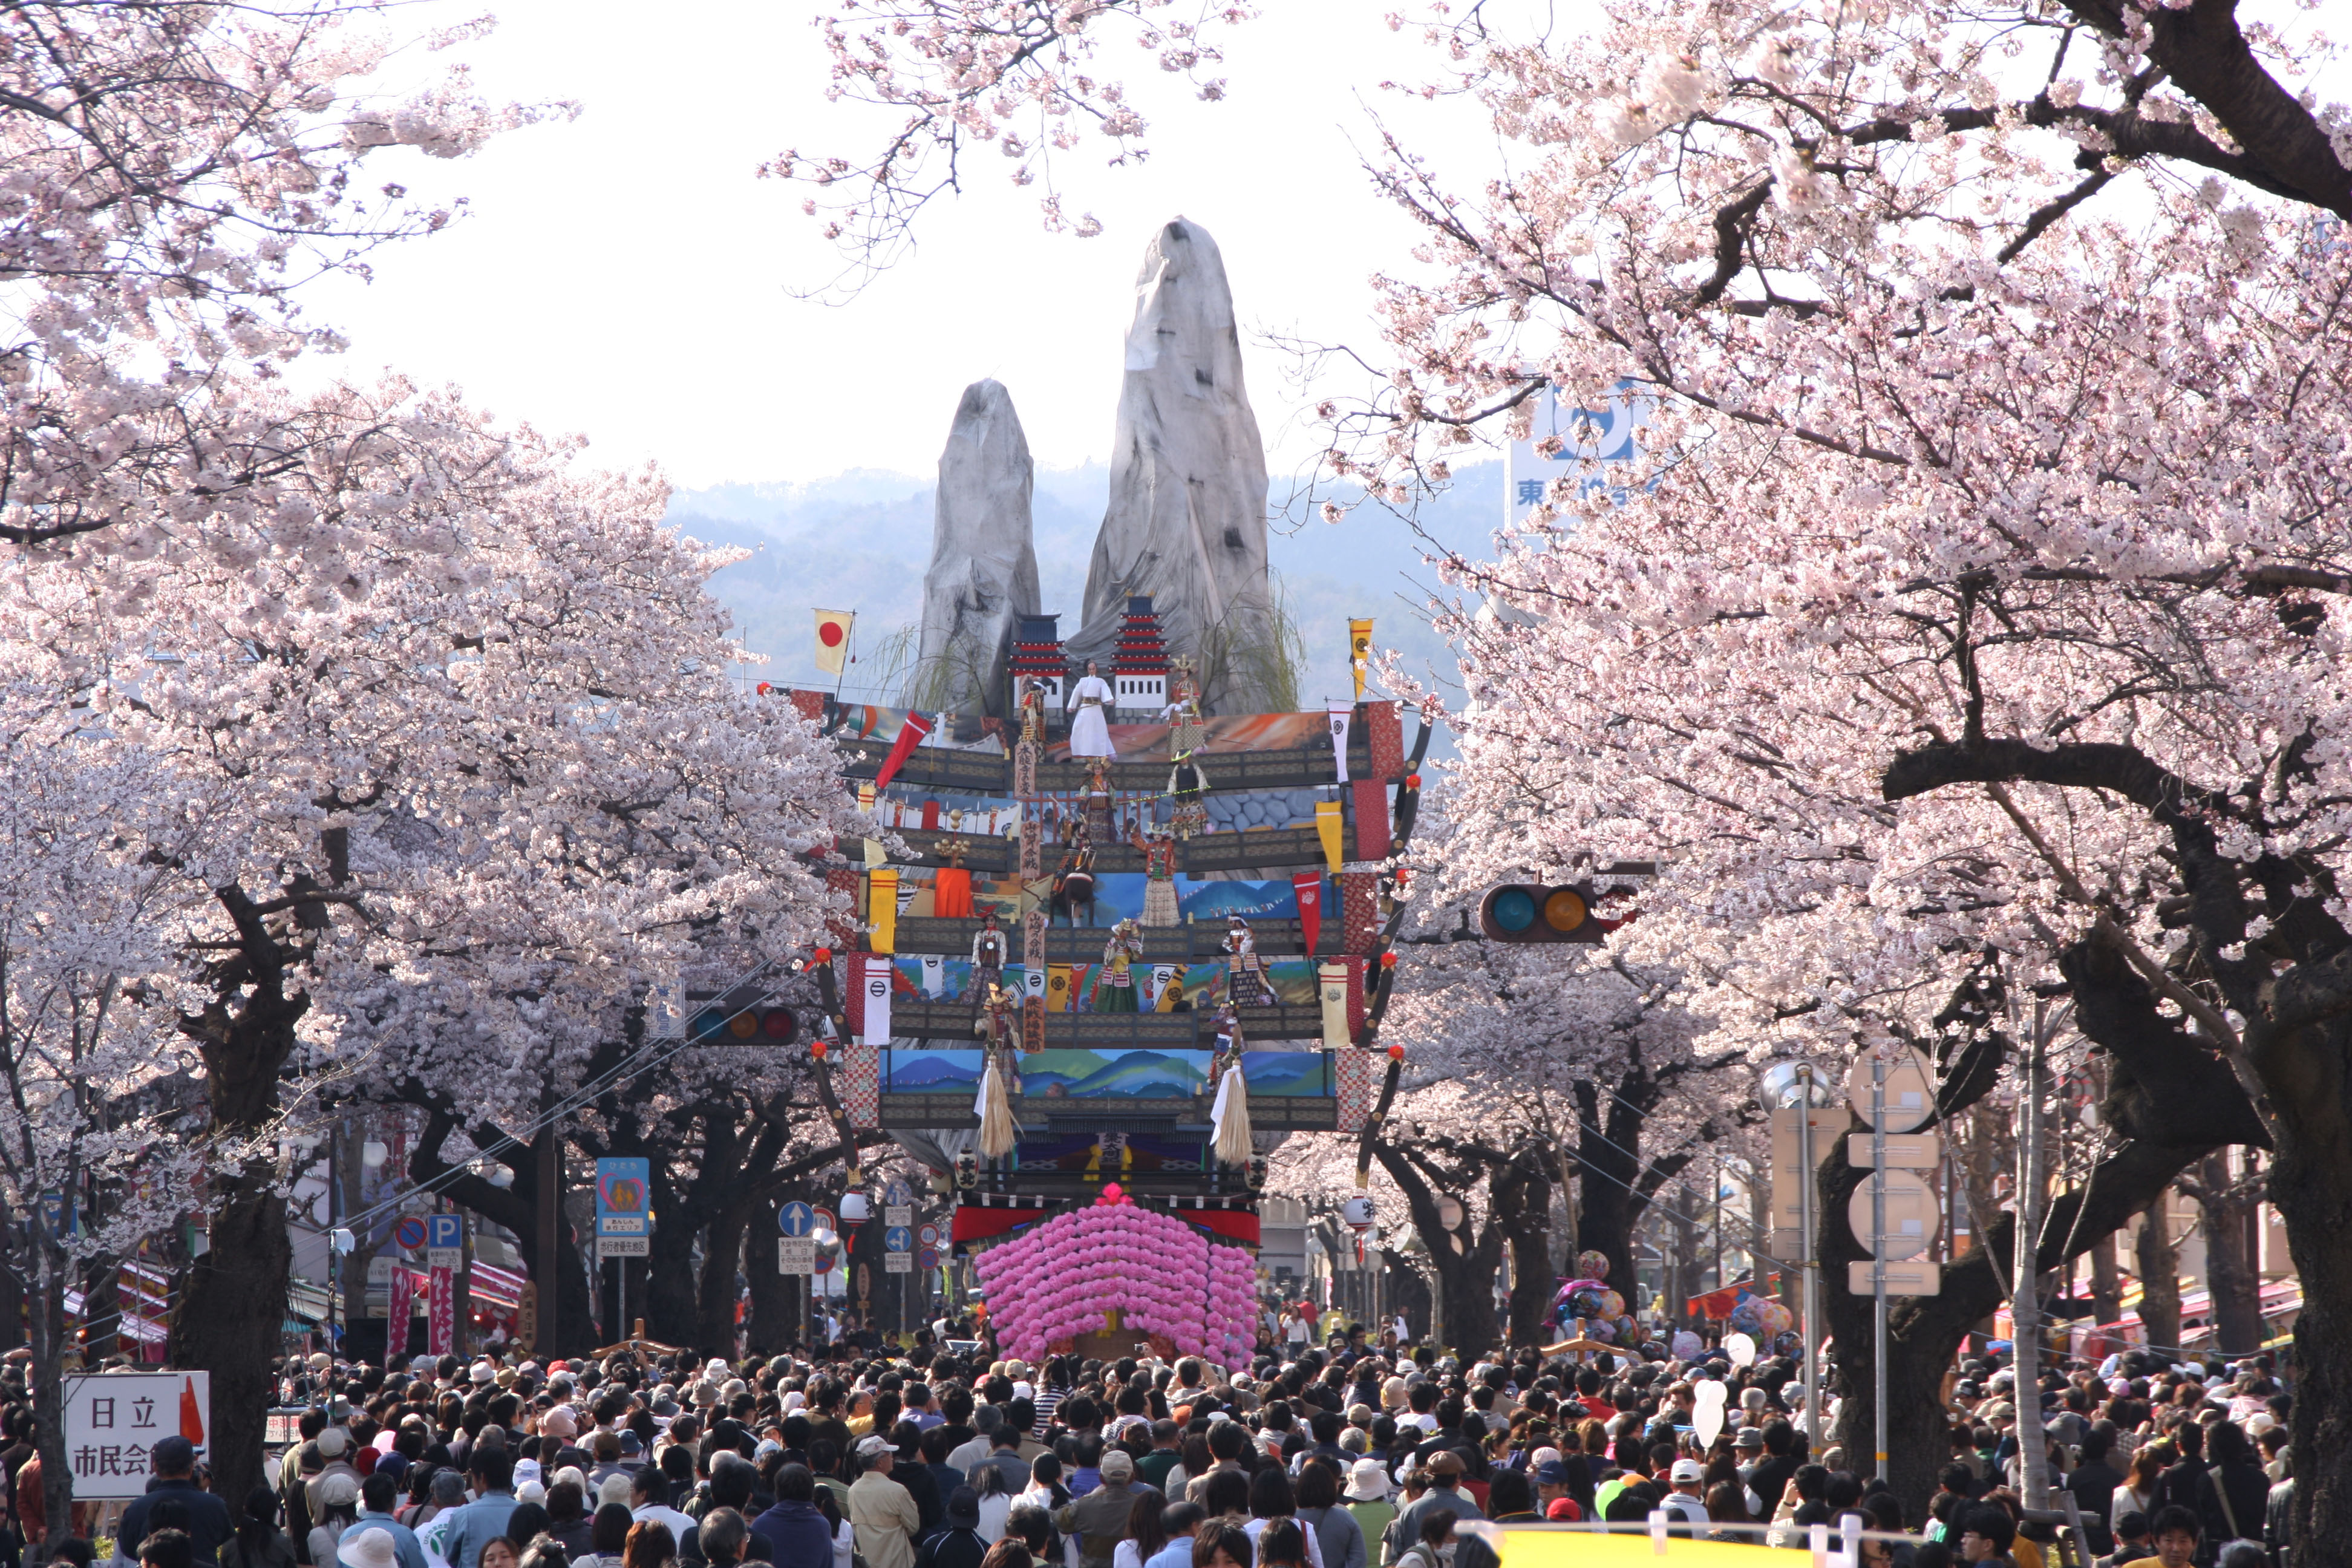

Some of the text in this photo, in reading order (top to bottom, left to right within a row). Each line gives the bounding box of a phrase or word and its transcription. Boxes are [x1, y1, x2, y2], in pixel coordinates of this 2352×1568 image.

[1027, 913, 1042, 959] 山崎の合戦
[436, 1218, 456, 1244] P
[922, 1230, 935, 1241] 40
[600, 1241, 645, 1252] 歩行者優先地区
[92, 1396, 157, 1429] 日立
[73, 1443, 158, 1477] 市民会
